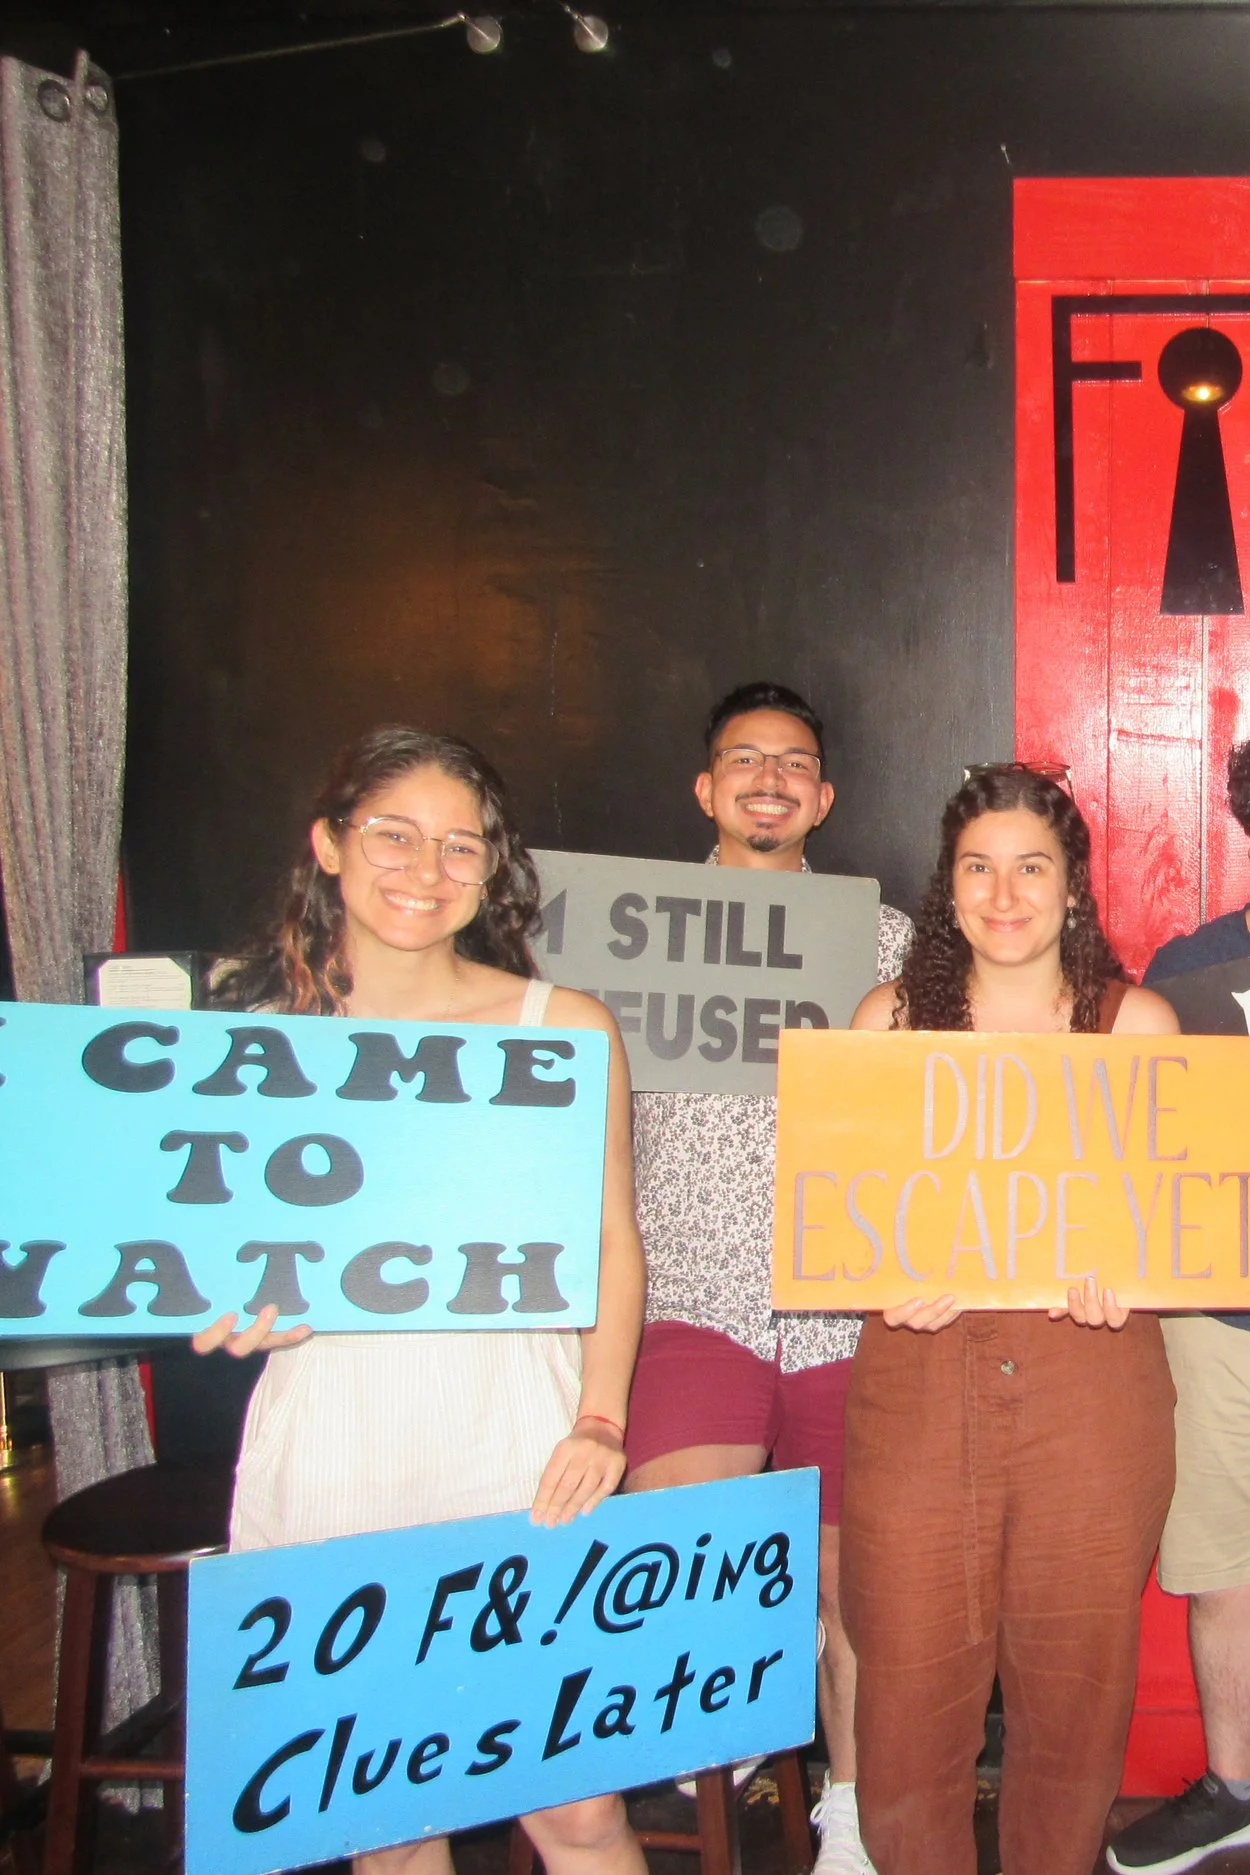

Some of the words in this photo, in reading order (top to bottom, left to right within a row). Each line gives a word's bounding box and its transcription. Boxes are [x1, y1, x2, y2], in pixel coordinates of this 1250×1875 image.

[607, 892, 804, 970] STILL
[82, 1021, 577, 1107] CAME
[582, 988, 829, 1063] FUSE
[923, 1052, 1037, 1160] DID
[1061, 1055, 1188, 1161] WE
[160, 1130, 364, 1207] TO
[793, 1170, 1098, 1281] ESCAPE
[232, 1596, 387, 1690] 20
[232, 1713, 521, 1833] Clues
[542, 1649, 784, 1761] Later
